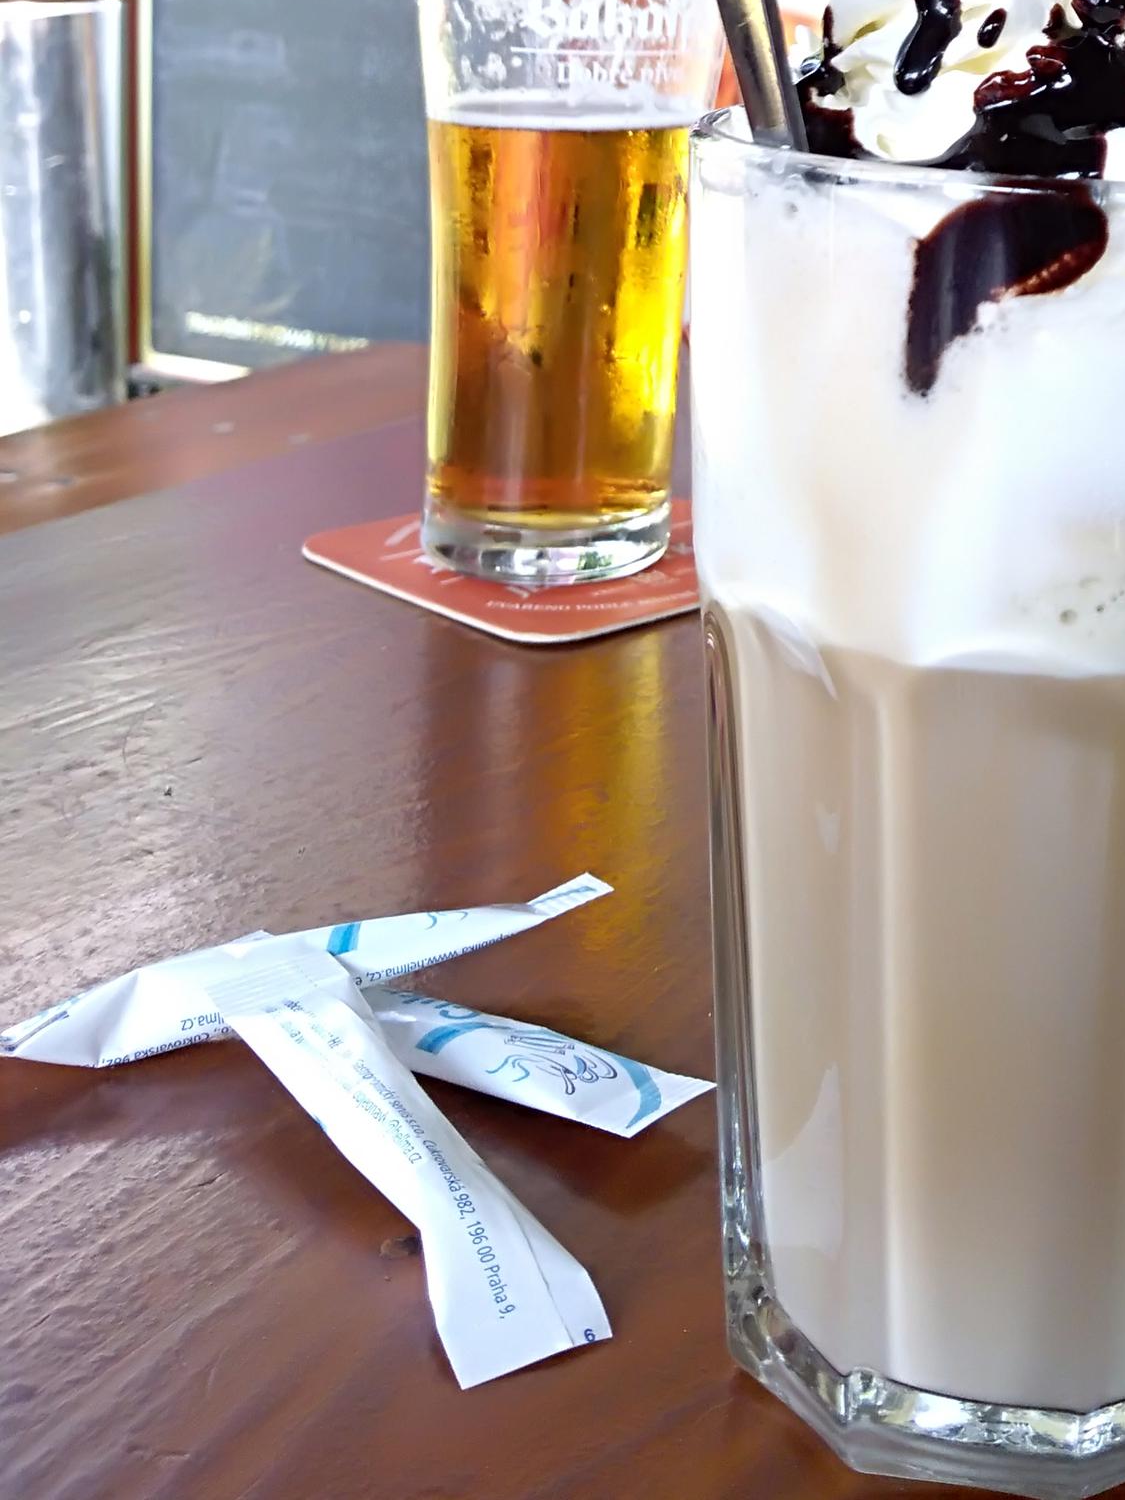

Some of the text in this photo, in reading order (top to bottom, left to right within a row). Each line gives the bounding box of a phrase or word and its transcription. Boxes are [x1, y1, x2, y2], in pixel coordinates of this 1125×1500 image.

[423, 1139, 461, 1193] Cukrovarská
[454, 1193, 477, 1220] 982,
[467, 1220, 489, 1245] 196
[477, 1245, 496, 1263] 00
[484, 1264, 509, 1305] Praha
[498, 1303, 517, 1319] 9,
